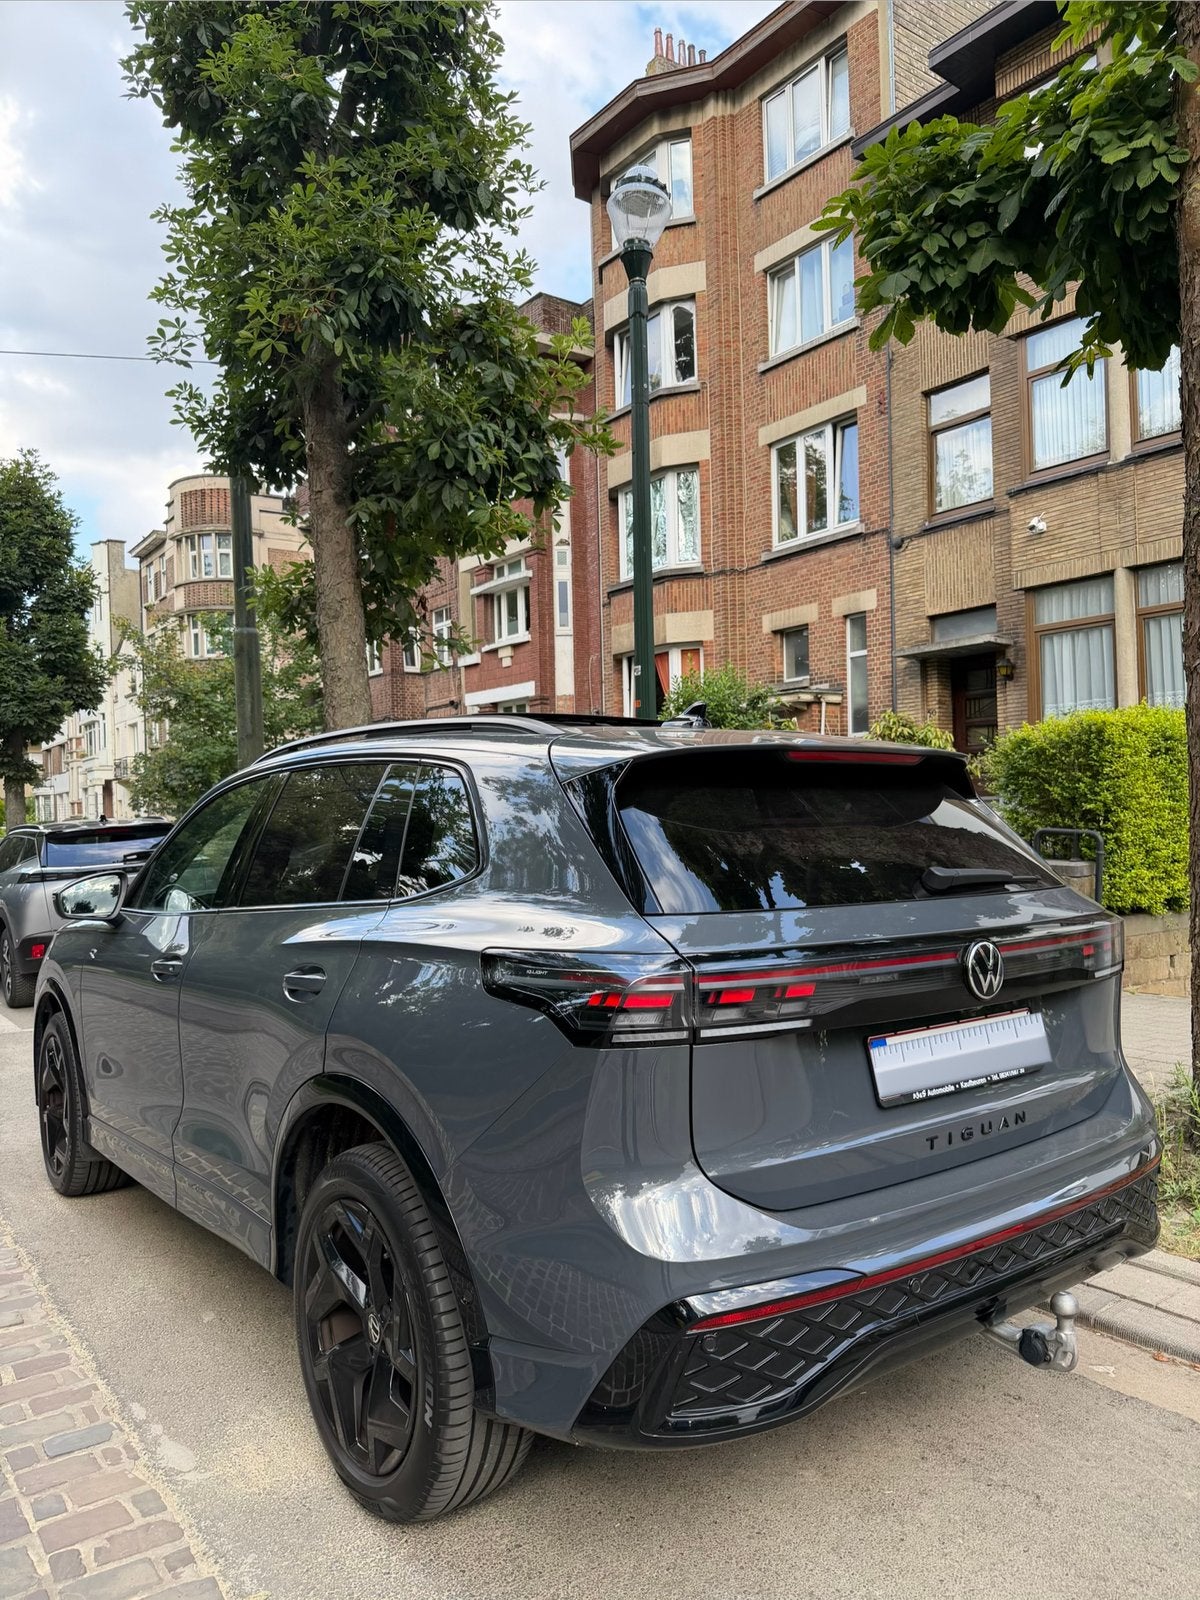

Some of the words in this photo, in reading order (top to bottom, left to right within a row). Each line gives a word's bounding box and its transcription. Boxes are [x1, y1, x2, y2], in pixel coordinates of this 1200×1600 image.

[927, 1084, 955, 1097] Automobile
[960, 1077, 987, 1089] Kaufbeuren
[925, 1110, 1027, 1151] TIGUAN
